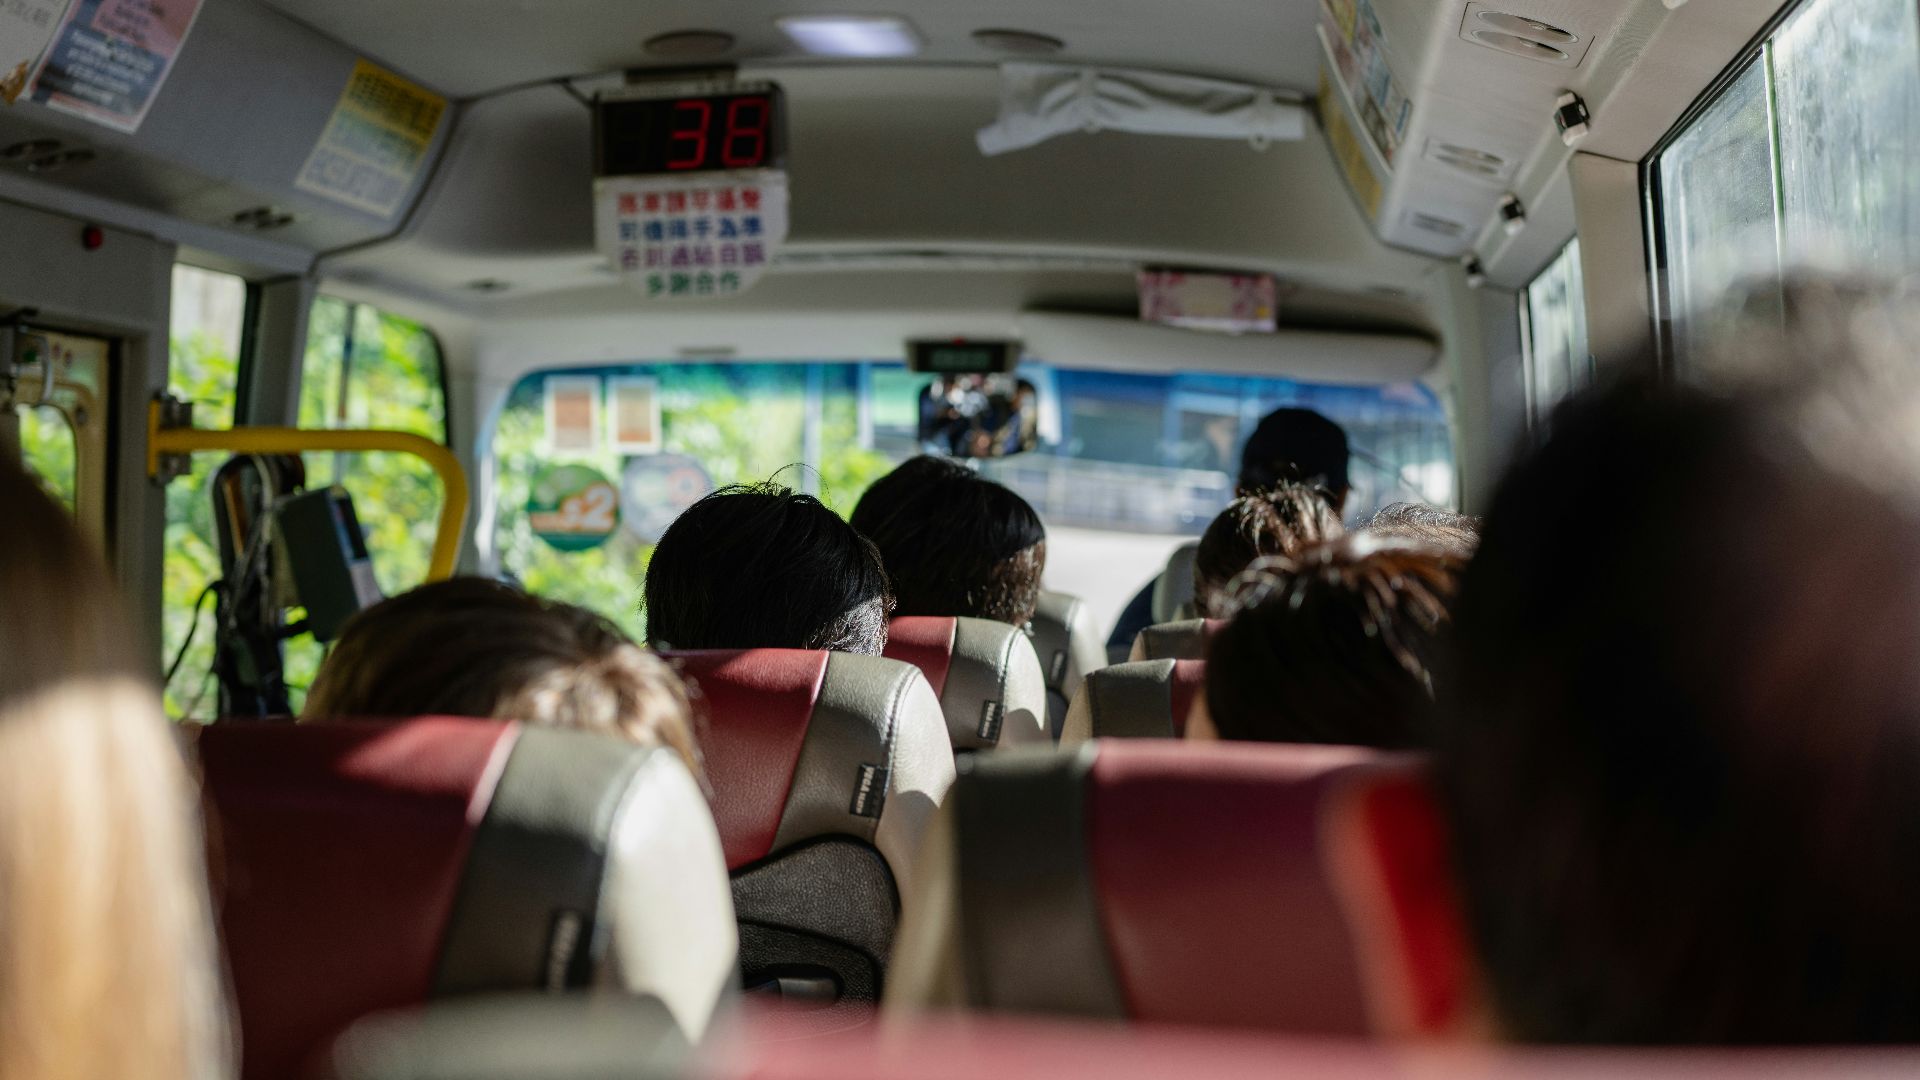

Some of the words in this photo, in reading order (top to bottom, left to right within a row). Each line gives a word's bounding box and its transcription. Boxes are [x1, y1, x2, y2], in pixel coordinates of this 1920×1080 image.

[666, 98, 770, 169] 38
[647, 271, 739, 296] 多謝合作
